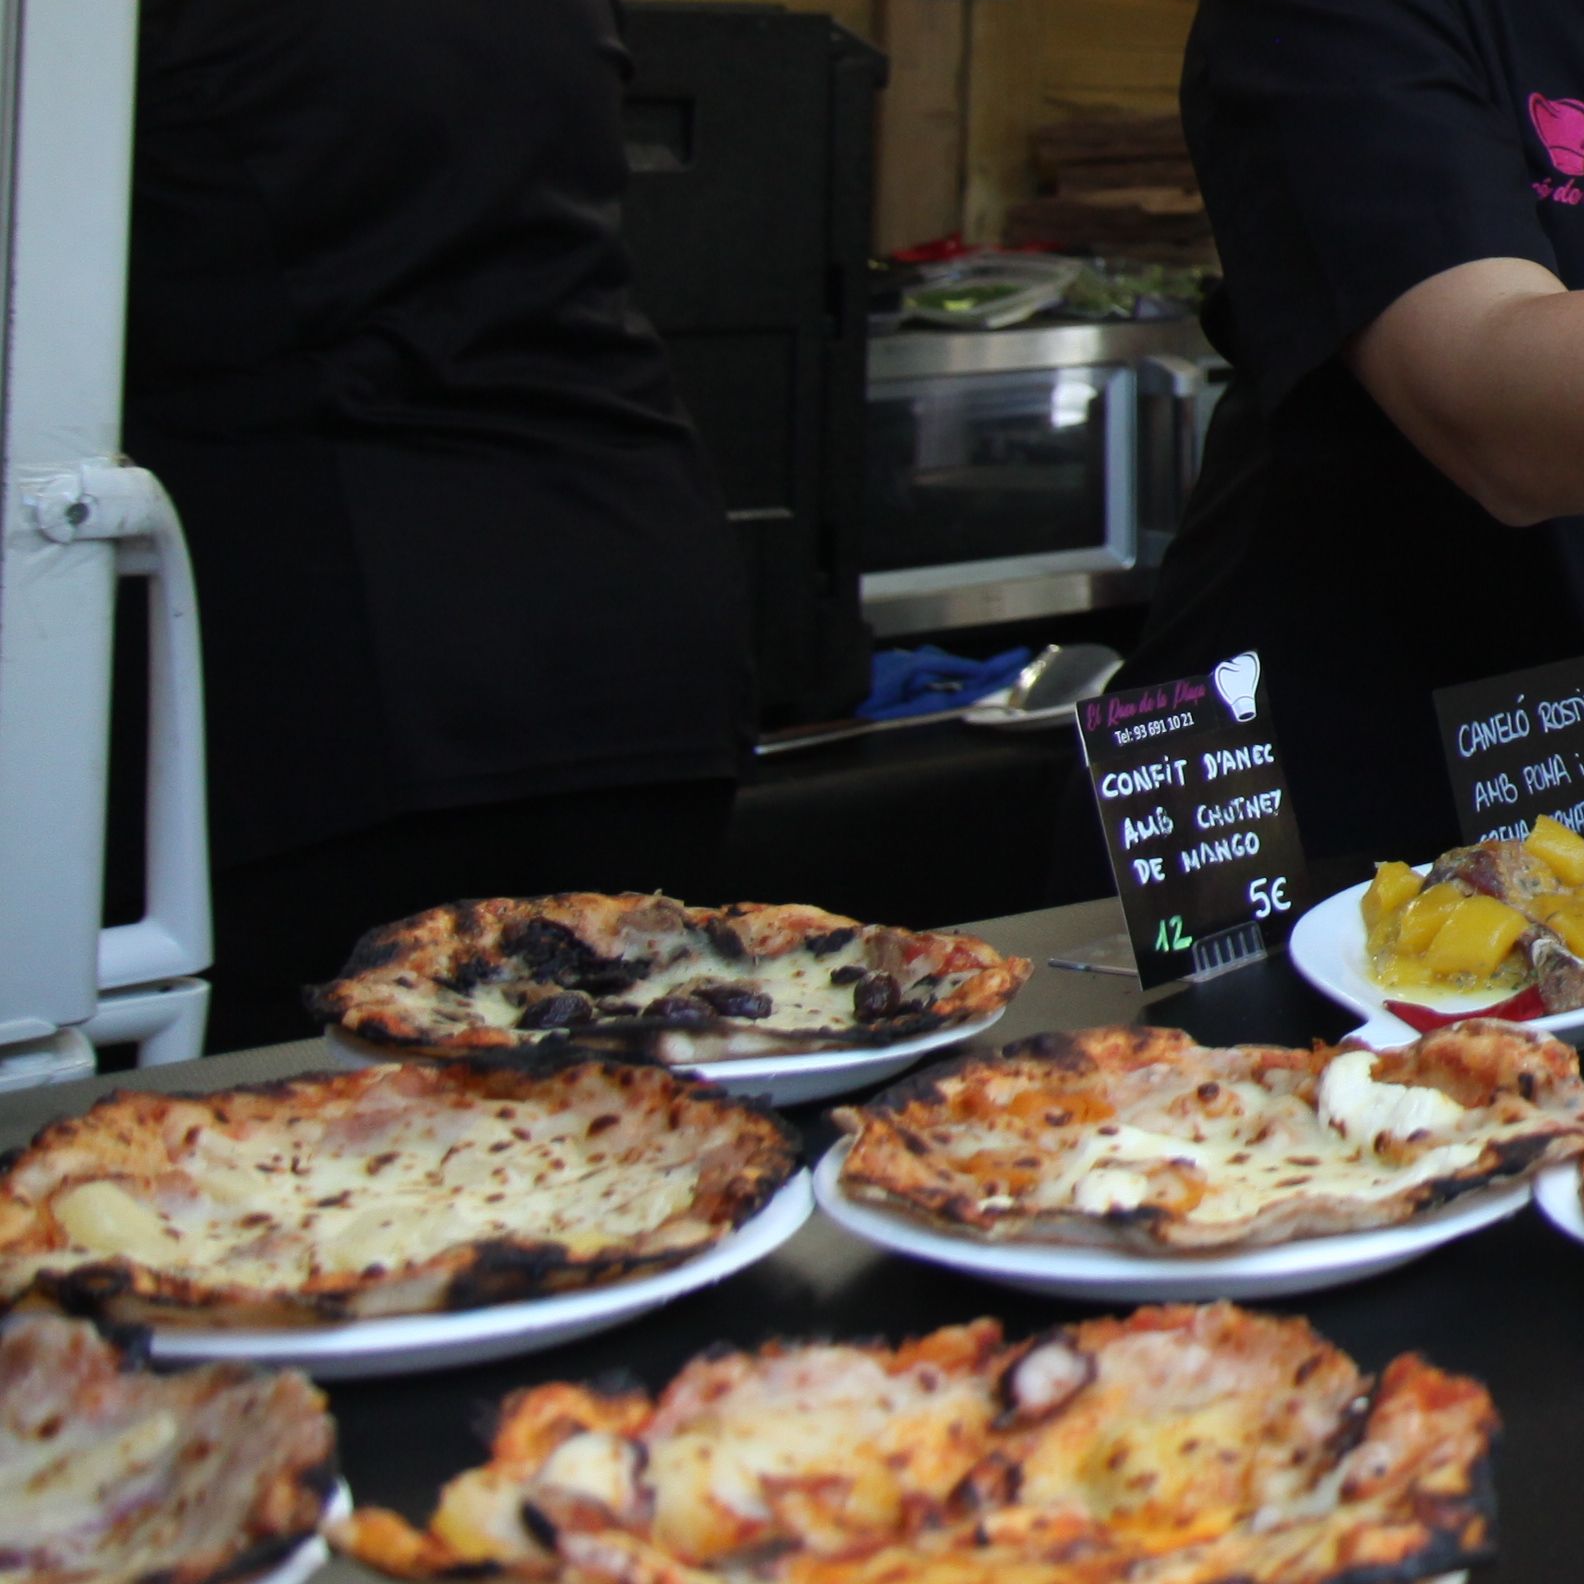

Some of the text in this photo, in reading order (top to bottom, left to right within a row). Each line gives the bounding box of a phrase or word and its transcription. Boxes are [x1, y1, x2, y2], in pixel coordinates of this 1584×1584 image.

[1114, 712, 1195, 745] Tel: 93 691 10 21
[1457, 694, 1529, 758] CANELÓ
[1203, 743, 1275, 780] D'ANEC
[1475, 772, 1519, 813] AMB
[1122, 806, 1175, 850] AMB
[1133, 831, 1261, 885] DE MANGO
[1249, 876, 1292, 918] 5€
[1155, 915, 1193, 953] 12
